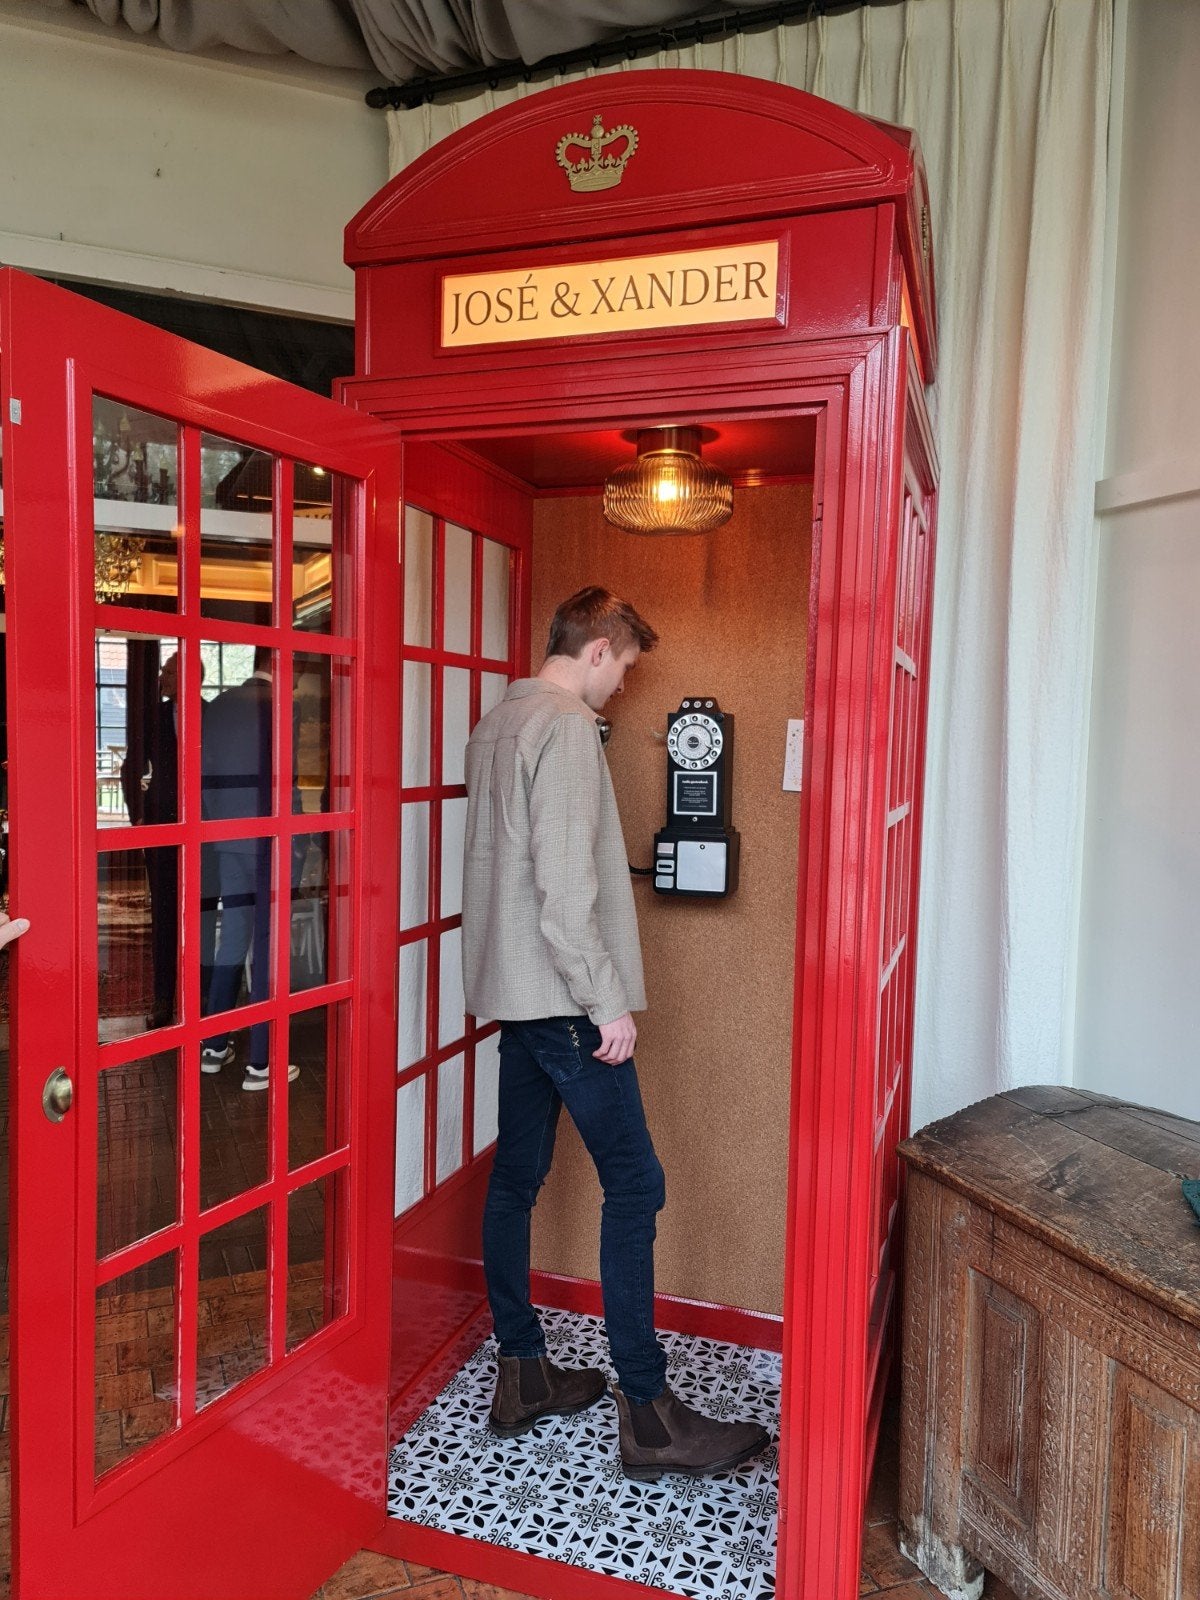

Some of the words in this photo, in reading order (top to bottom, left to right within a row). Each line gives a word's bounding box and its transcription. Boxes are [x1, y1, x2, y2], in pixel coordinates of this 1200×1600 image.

[451, 273, 539, 335] JOSÉ
[550, 281, 581, 319] &
[590, 261, 769, 315] XANDER
